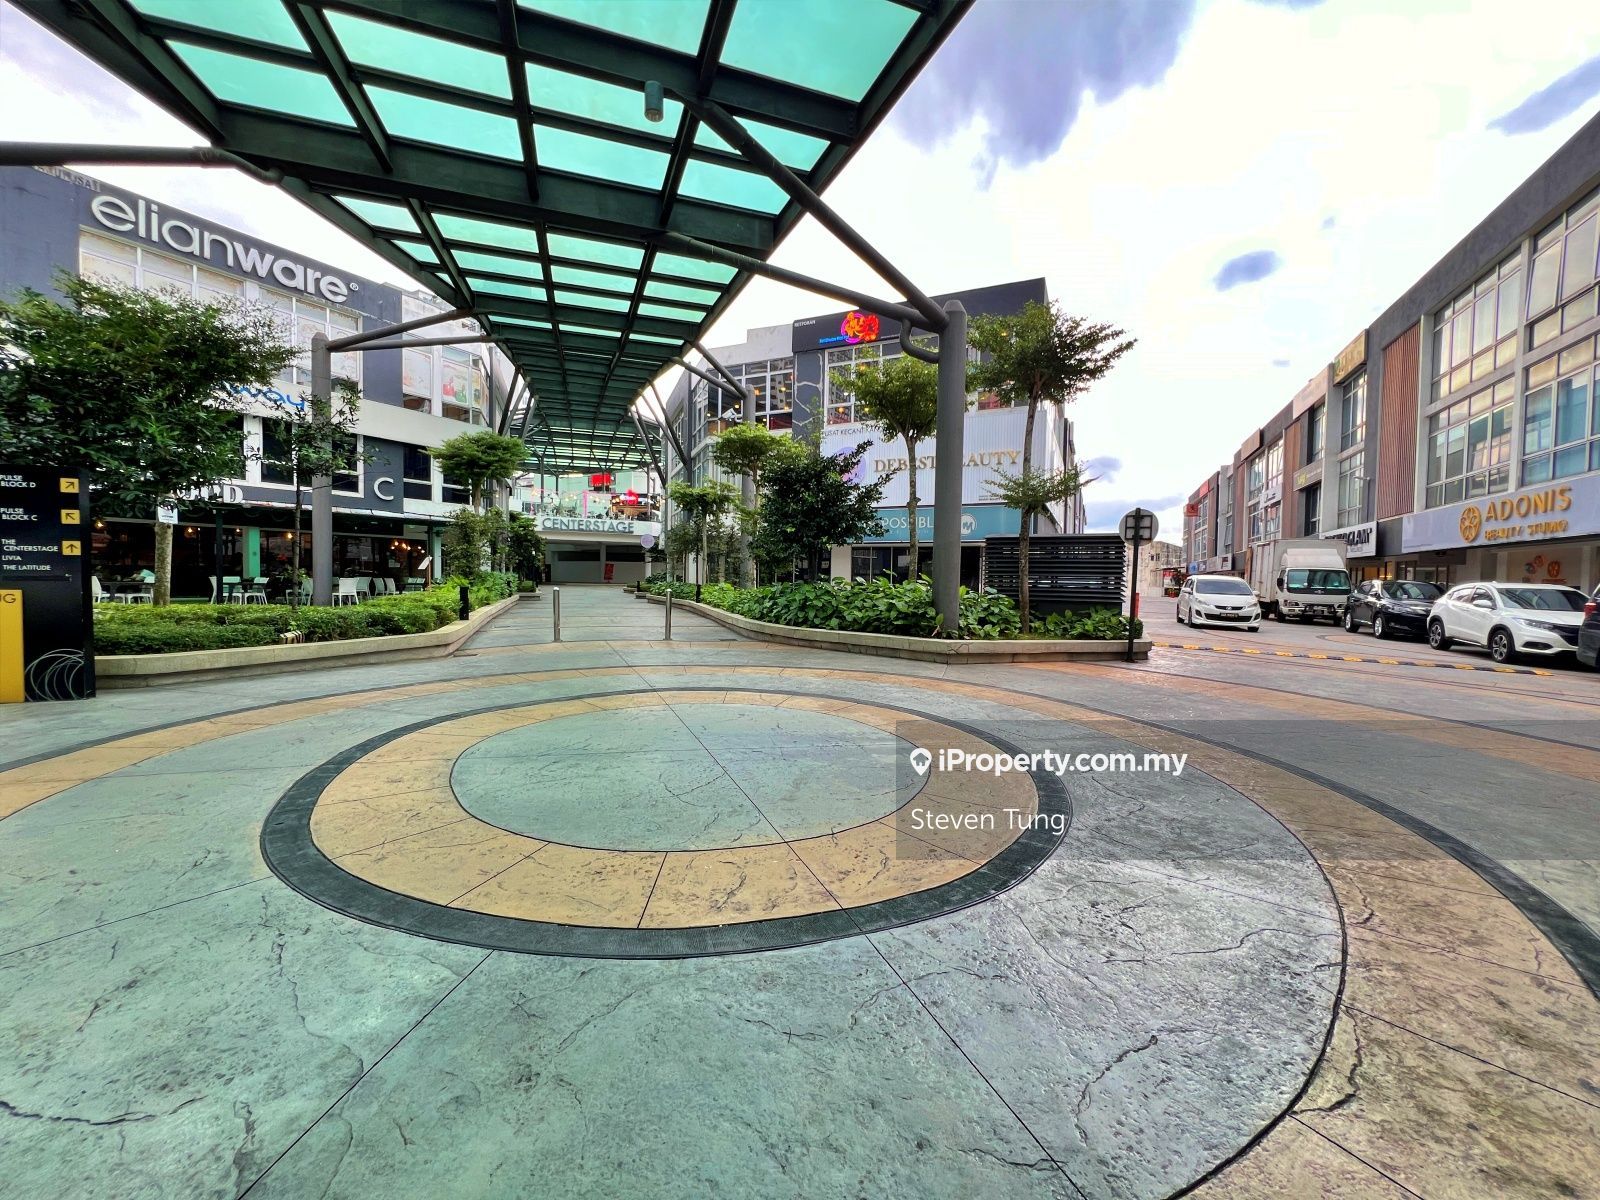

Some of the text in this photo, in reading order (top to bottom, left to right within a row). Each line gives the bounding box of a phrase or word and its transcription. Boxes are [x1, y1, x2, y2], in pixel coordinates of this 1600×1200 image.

[874, 455, 937, 473] DEBST
[373, 477, 395, 501] C
[1484, 486, 1572, 523] ADONIS
[542, 517, 635, 534] CENTERSTAGE
